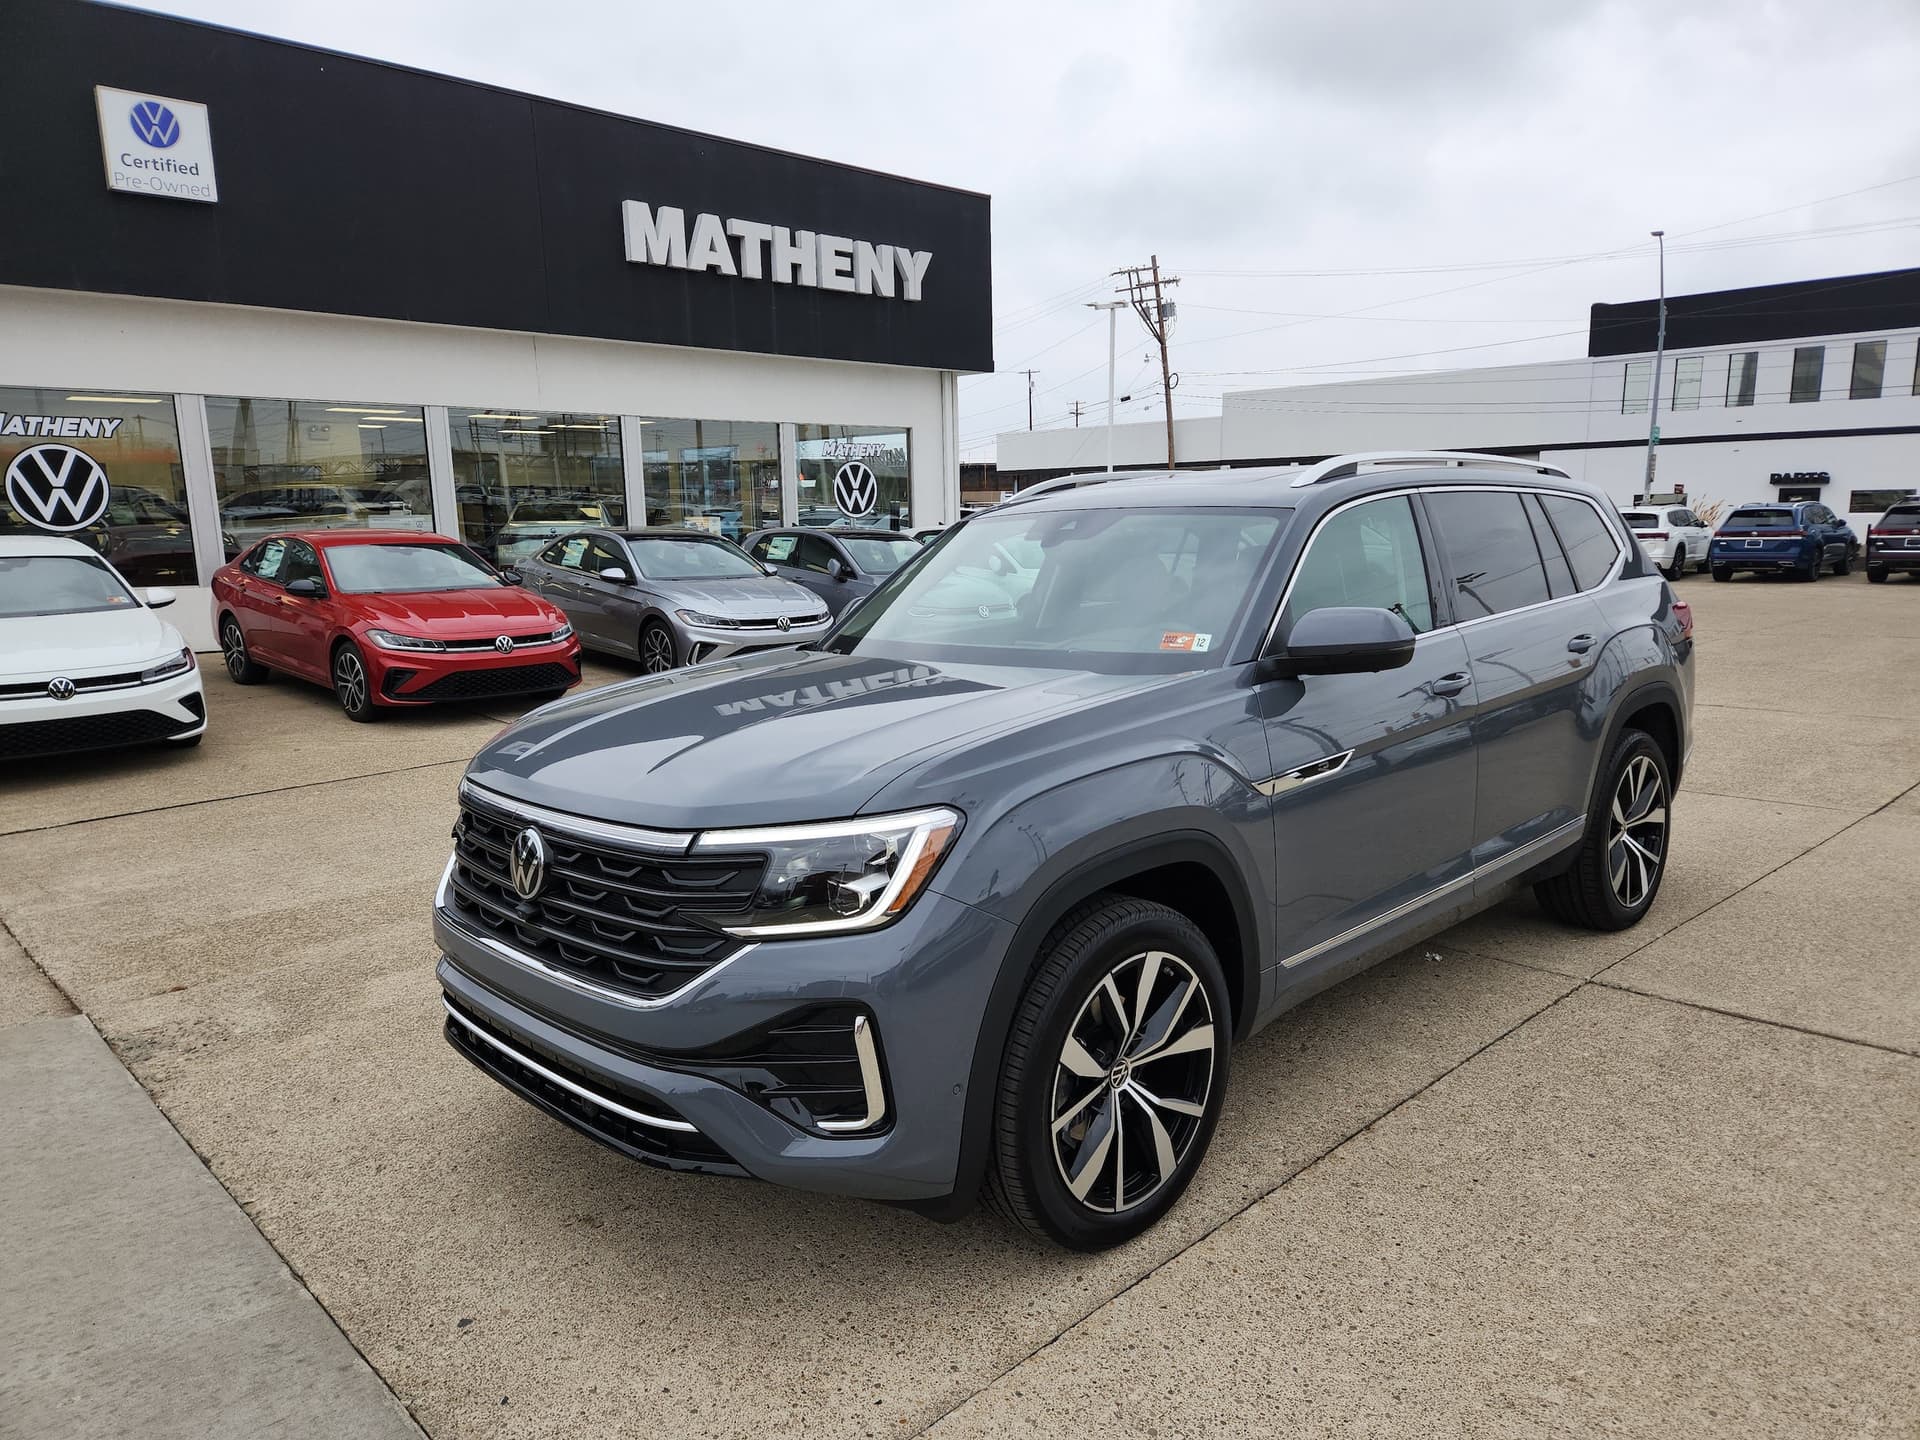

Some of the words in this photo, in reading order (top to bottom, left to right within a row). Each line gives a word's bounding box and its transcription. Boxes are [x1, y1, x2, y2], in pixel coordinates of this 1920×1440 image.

[120, 152, 200, 176] Certified
[113, 171, 211, 197] Pre-Owned
[622, 199, 933, 302] MATHENY
[0, 412, 123, 438] ATHENY
[822, 441, 885, 458] MATHENY
[1196, 638, 1206, 647] 12
